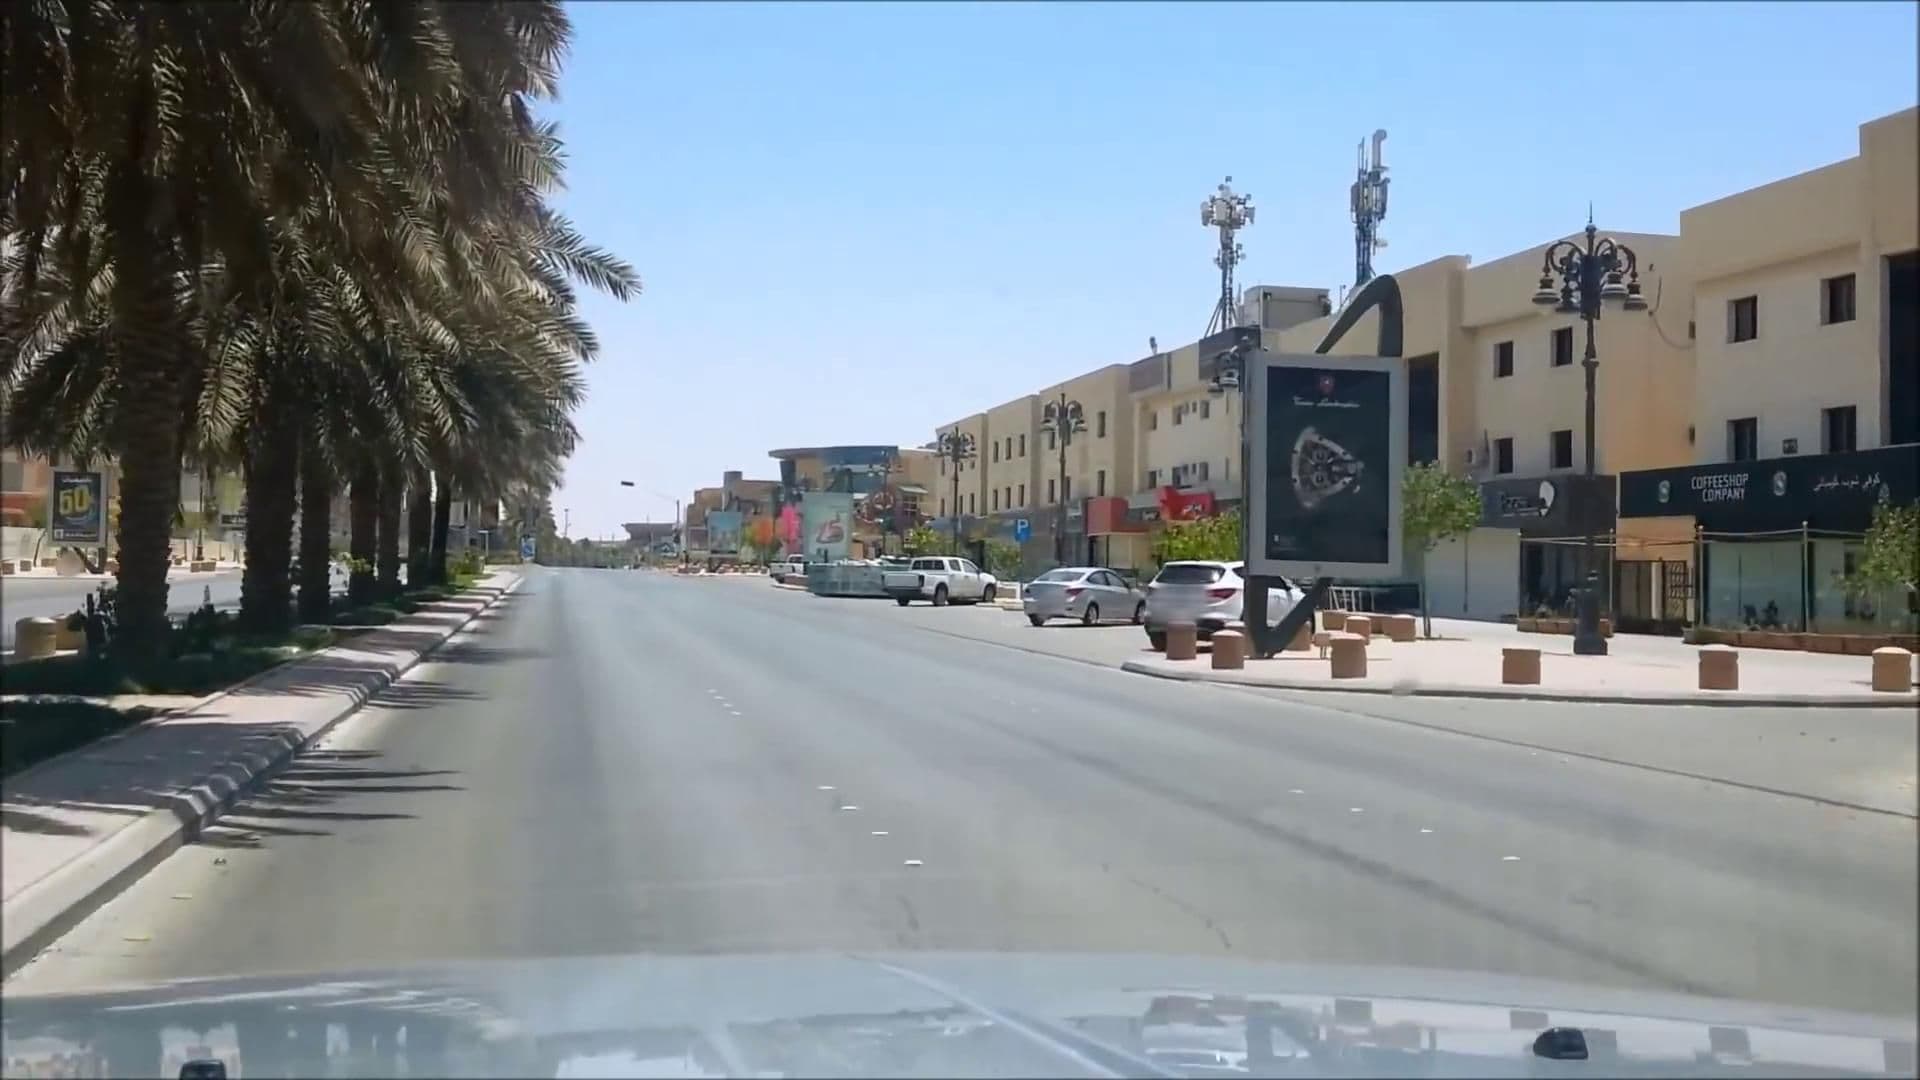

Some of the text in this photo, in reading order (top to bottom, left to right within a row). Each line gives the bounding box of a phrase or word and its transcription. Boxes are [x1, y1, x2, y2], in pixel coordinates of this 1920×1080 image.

[1691, 473, 1749, 489] COFFEESHOP
[1703, 487, 1745, 503] COMPANY
[1017, 518, 1029, 534] P
